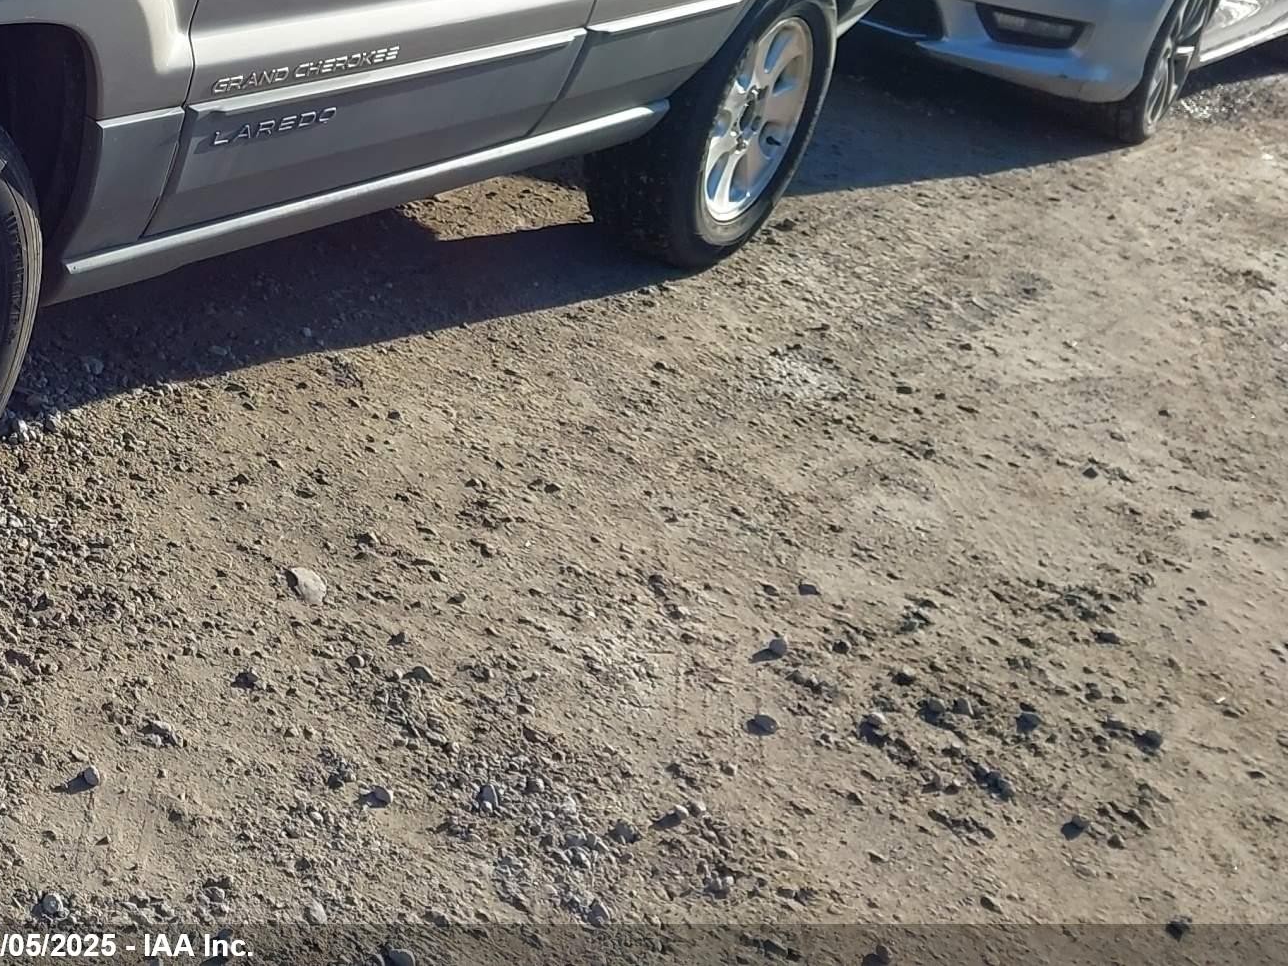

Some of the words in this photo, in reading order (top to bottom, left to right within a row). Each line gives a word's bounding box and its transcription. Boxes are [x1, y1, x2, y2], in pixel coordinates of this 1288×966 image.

[213, 66, 289, 94] GRAND
[295, 45, 400, 79] CHEROKEE
[213, 106, 337, 146] LAREDO
